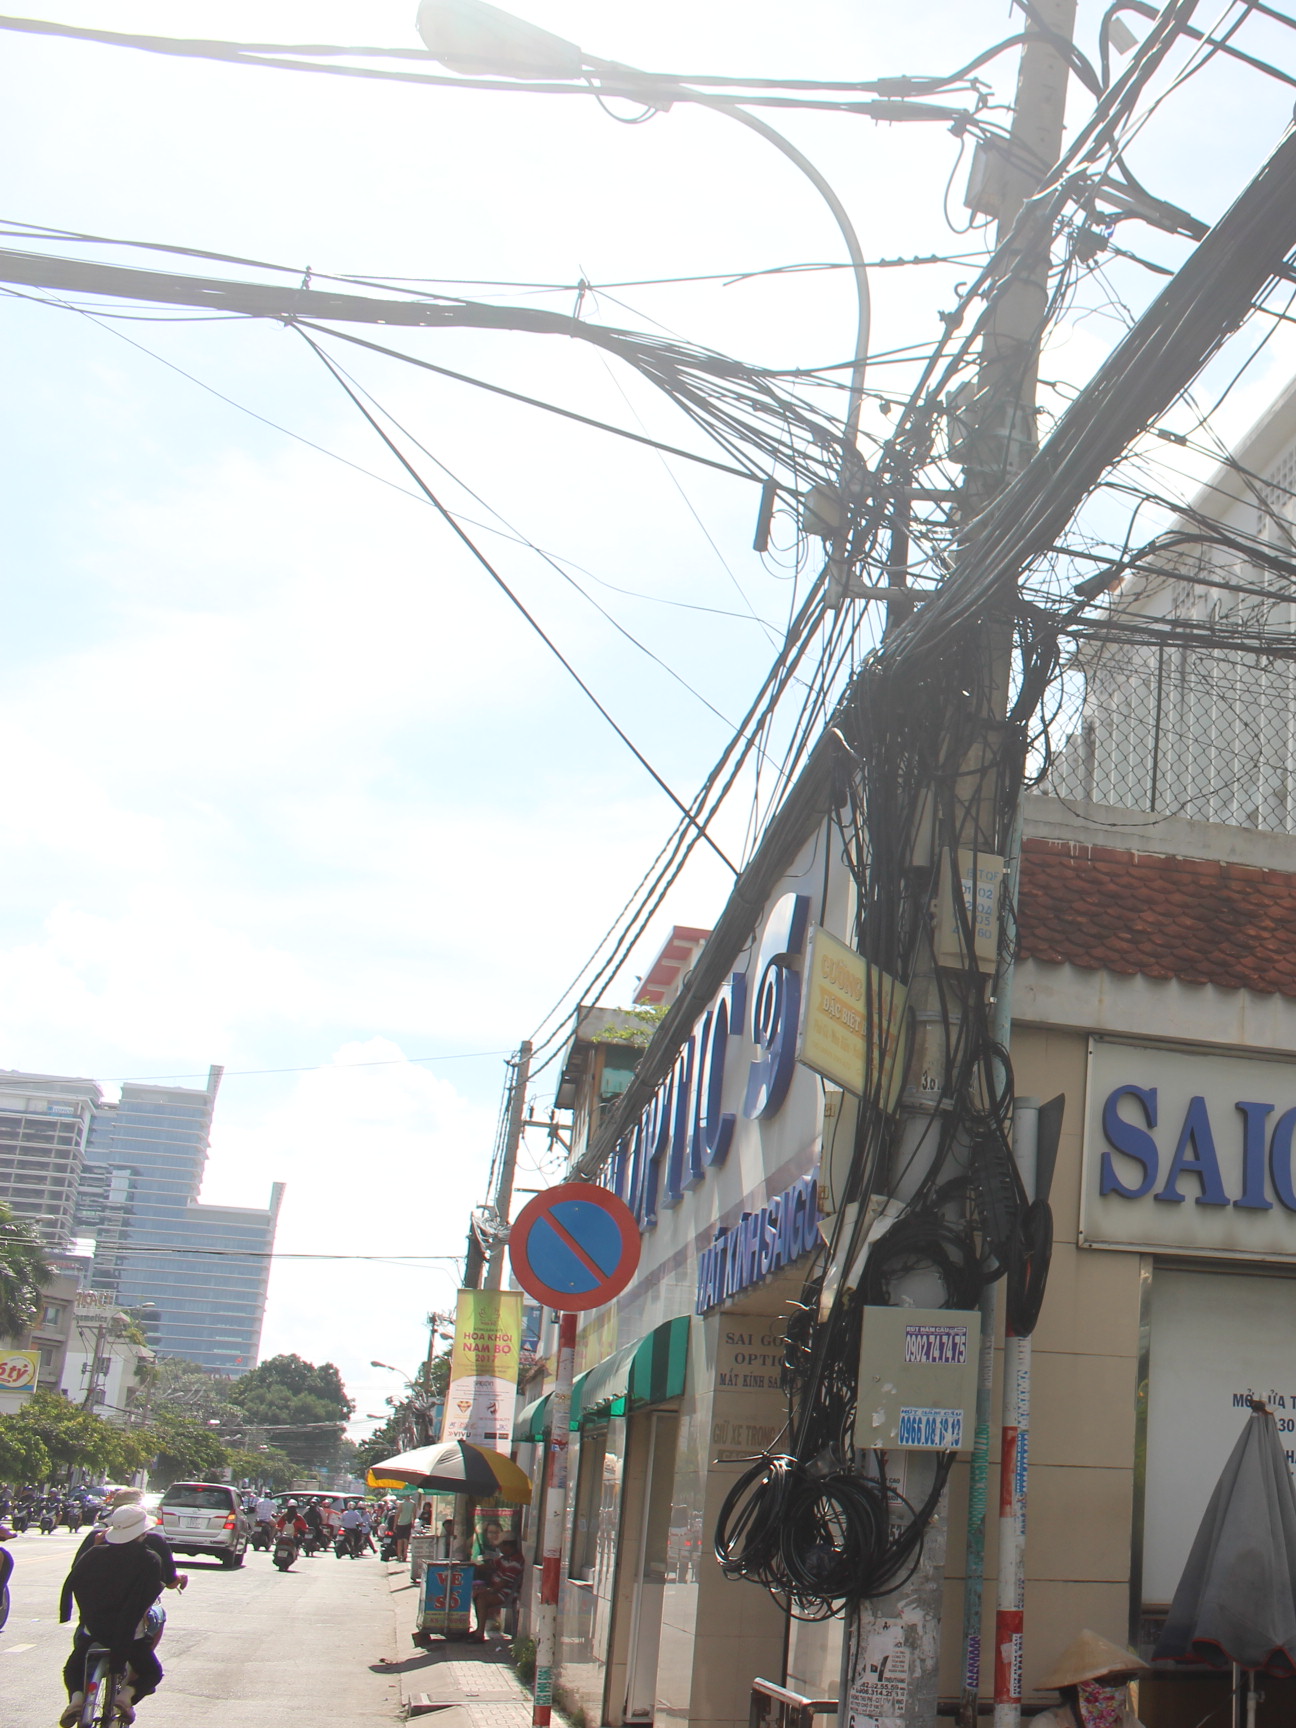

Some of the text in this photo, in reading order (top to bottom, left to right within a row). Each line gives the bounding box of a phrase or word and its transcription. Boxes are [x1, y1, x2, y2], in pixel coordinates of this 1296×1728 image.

[462, 1342, 490, 1354] NAM
[726, 1332, 787, 1348] SAI GO
[1266, 1389, 1286, 1409] ỬA
